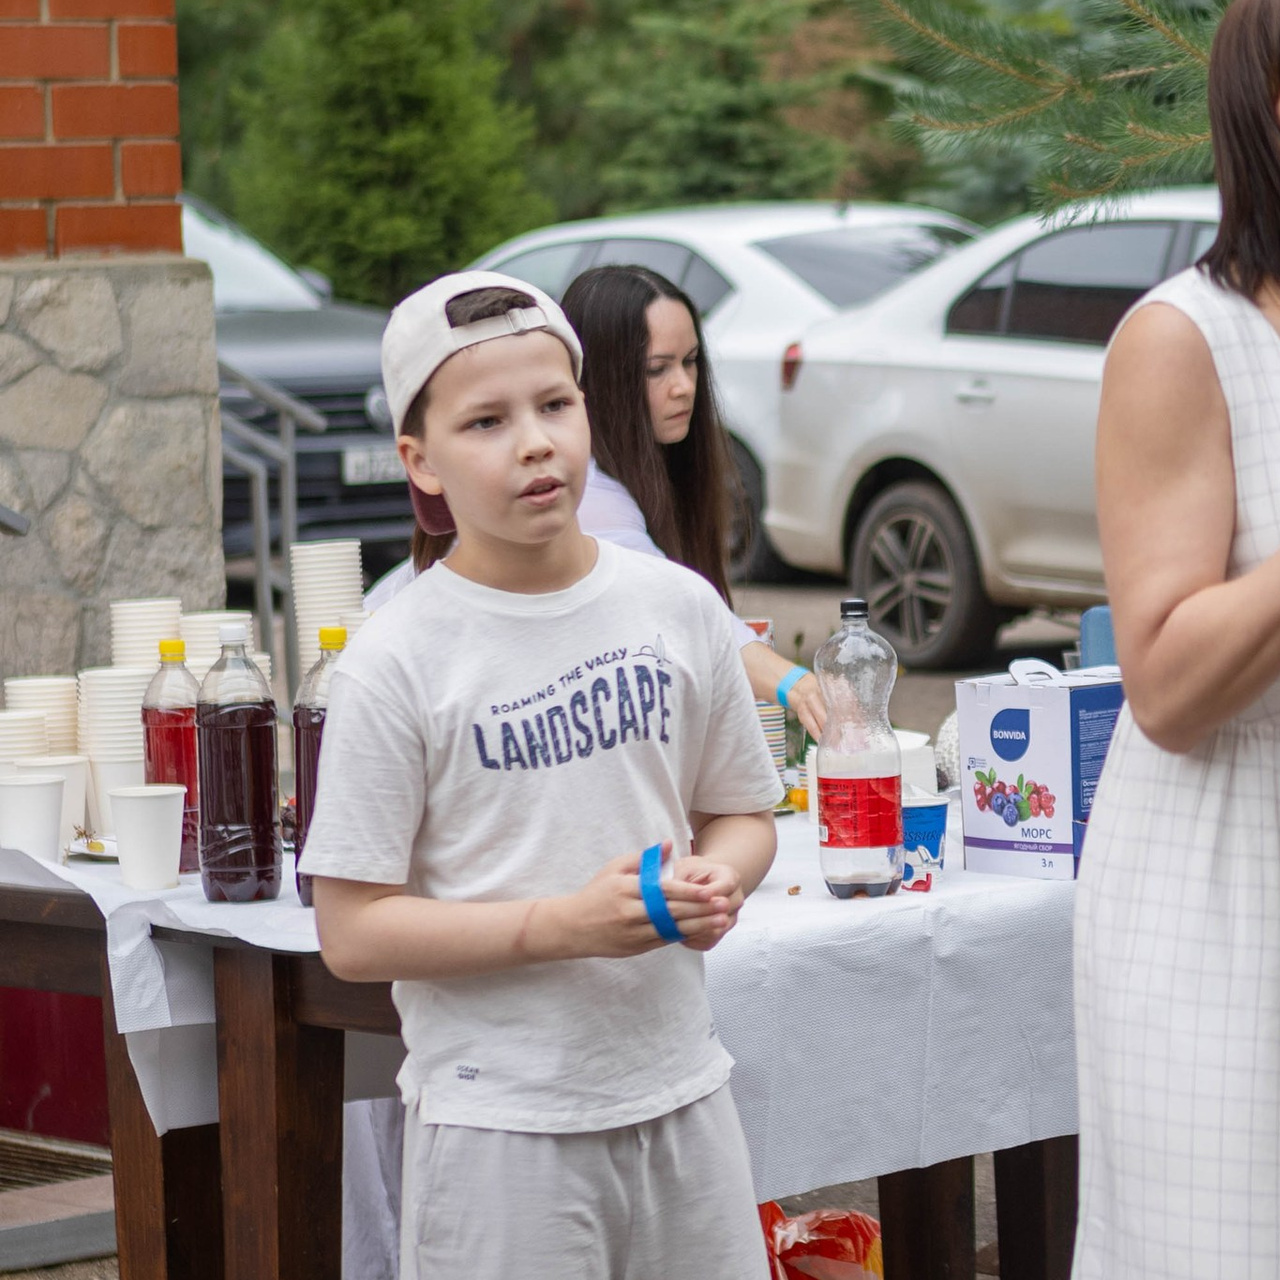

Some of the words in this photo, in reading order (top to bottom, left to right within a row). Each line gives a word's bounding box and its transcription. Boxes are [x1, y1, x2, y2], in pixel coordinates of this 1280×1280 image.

[491, 684, 556, 716] ROAMING
[558, 666, 584, 688] THE
[585, 647, 628, 671] VACAY
[472, 664, 672, 771] LANDSCAPE
[993, 730, 1026, 740] BONVIDA
[1021, 827, 1053, 839] МОРС
[1041, 858, 1048, 868] 3
